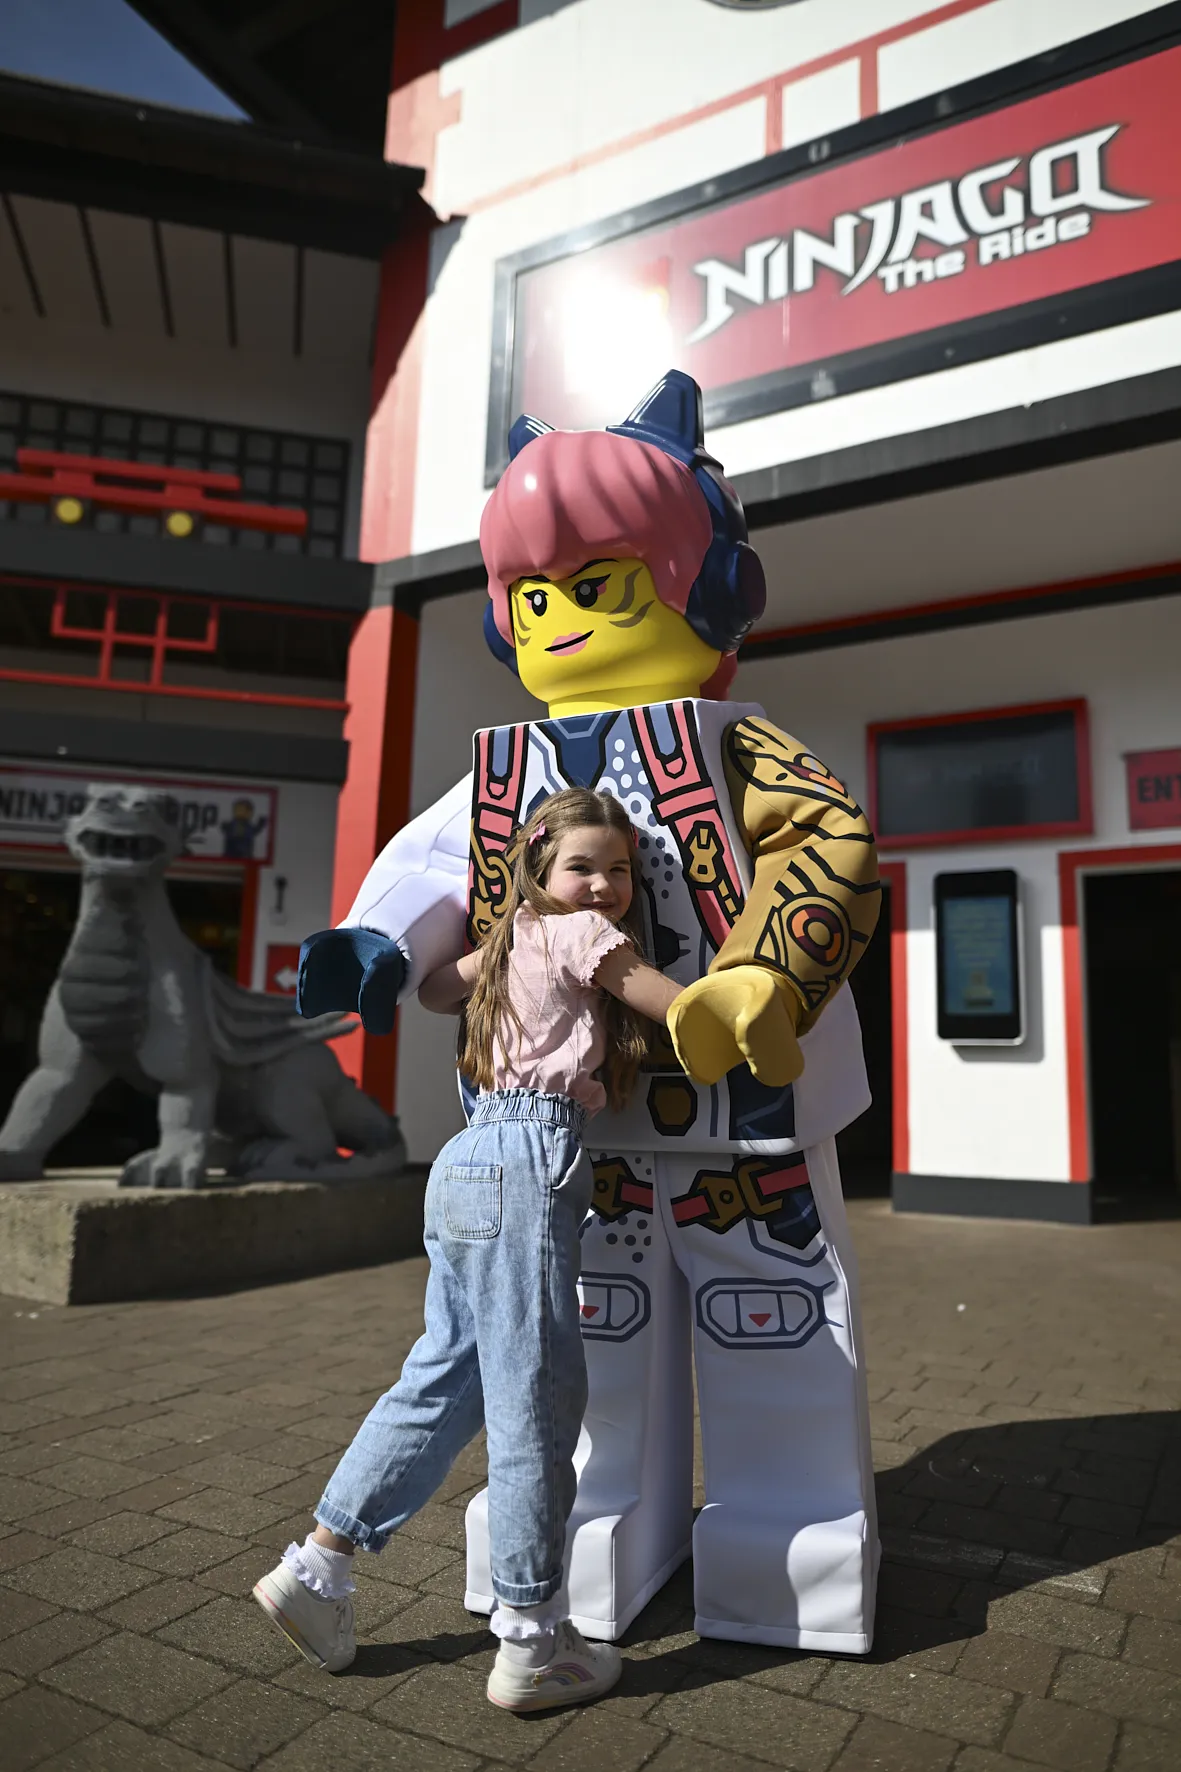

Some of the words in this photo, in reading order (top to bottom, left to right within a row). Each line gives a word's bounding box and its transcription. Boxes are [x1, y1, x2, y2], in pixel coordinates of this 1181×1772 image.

[685, 123, 1153, 344] NINJAGO
[877, 250, 966, 294] The
[979, 211, 1091, 266] Ride
[0, 784, 86, 821] NINJA
